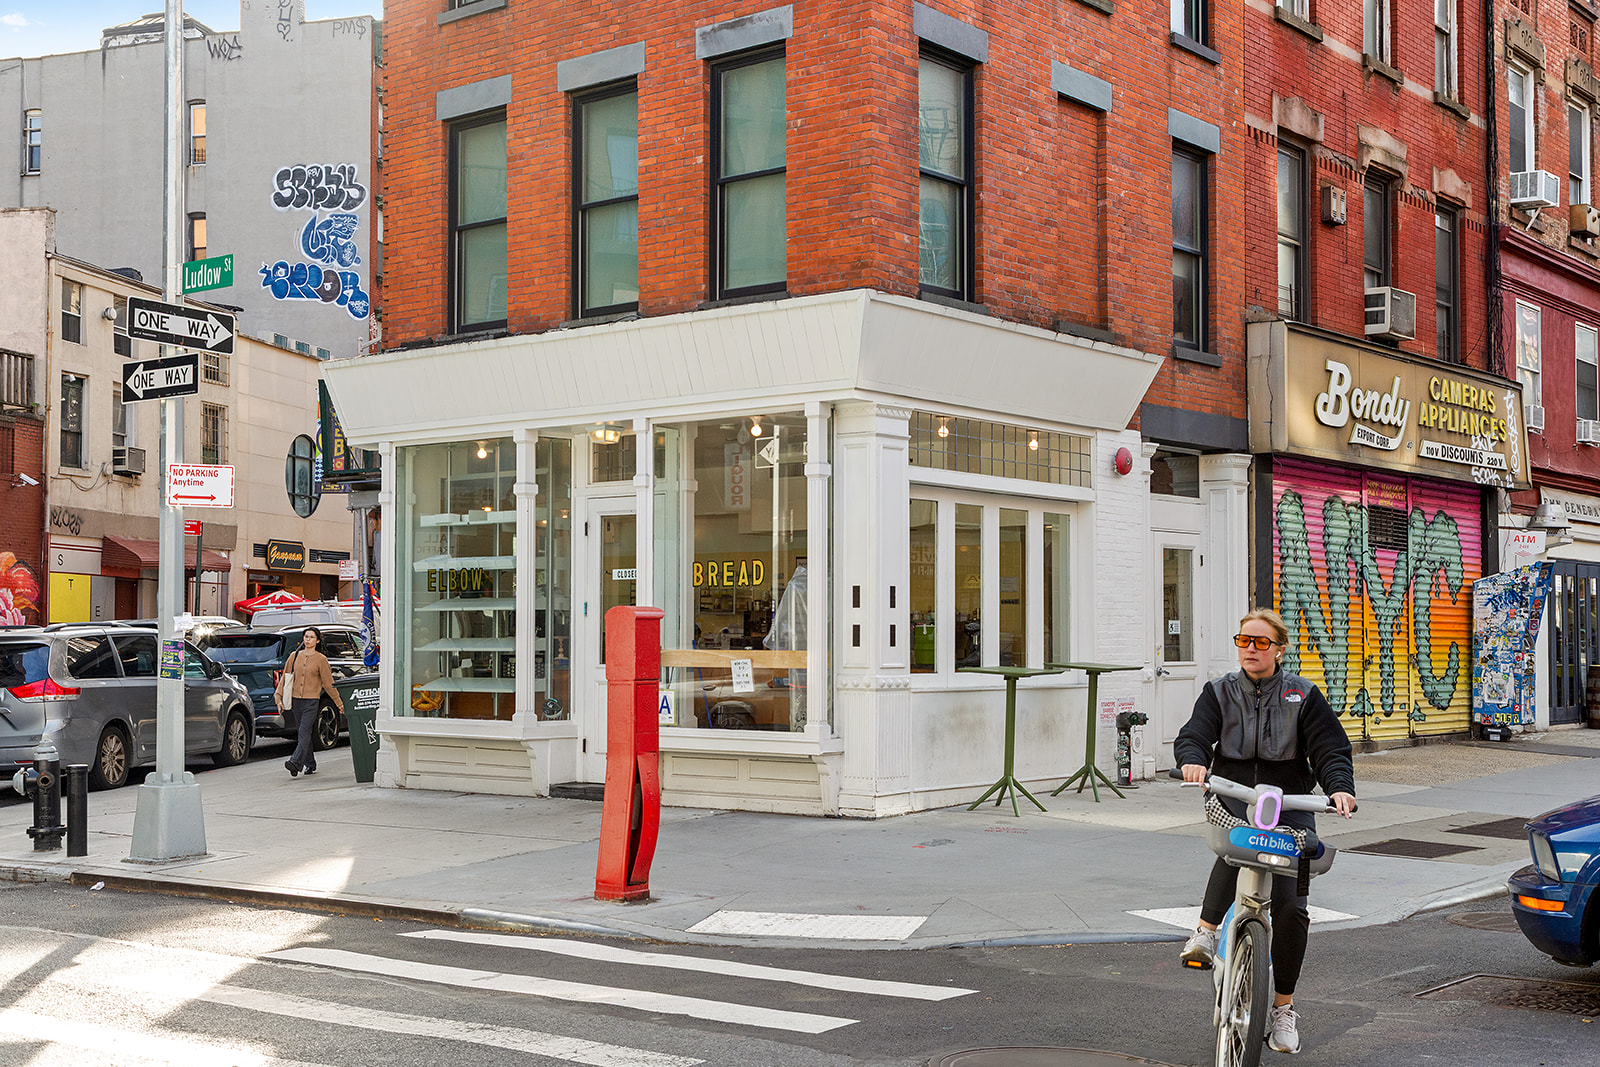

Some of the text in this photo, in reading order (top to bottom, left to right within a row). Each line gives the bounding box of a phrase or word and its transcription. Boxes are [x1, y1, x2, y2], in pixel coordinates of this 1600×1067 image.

[185, 257, 231, 289] Ludlow St
[138, 311, 220, 339] ONE WAY
[134, 367, 188, 389] ONE WAY
[1314, 359, 1411, 440] Bondy
[1429, 376, 1497, 414] CAMERAS
[1418, 401, 1507, 442] APPLIANCES
[1357, 428, 1375, 443] EXPORT
[1441, 445, 1484, 465] DISCOUNTS
[173, 478, 204, 487] Anytime
[186, 469, 219, 477] PARKING
[1564, 501, 1600, 517] GENERA
[1513, 535, 1536, 543] ATM
[428, 567, 483, 592] ELBOW
[693, 559, 765, 587] BREAD
[659, 695, 671, 714] A
[1269, 838, 1294, 851] bike
